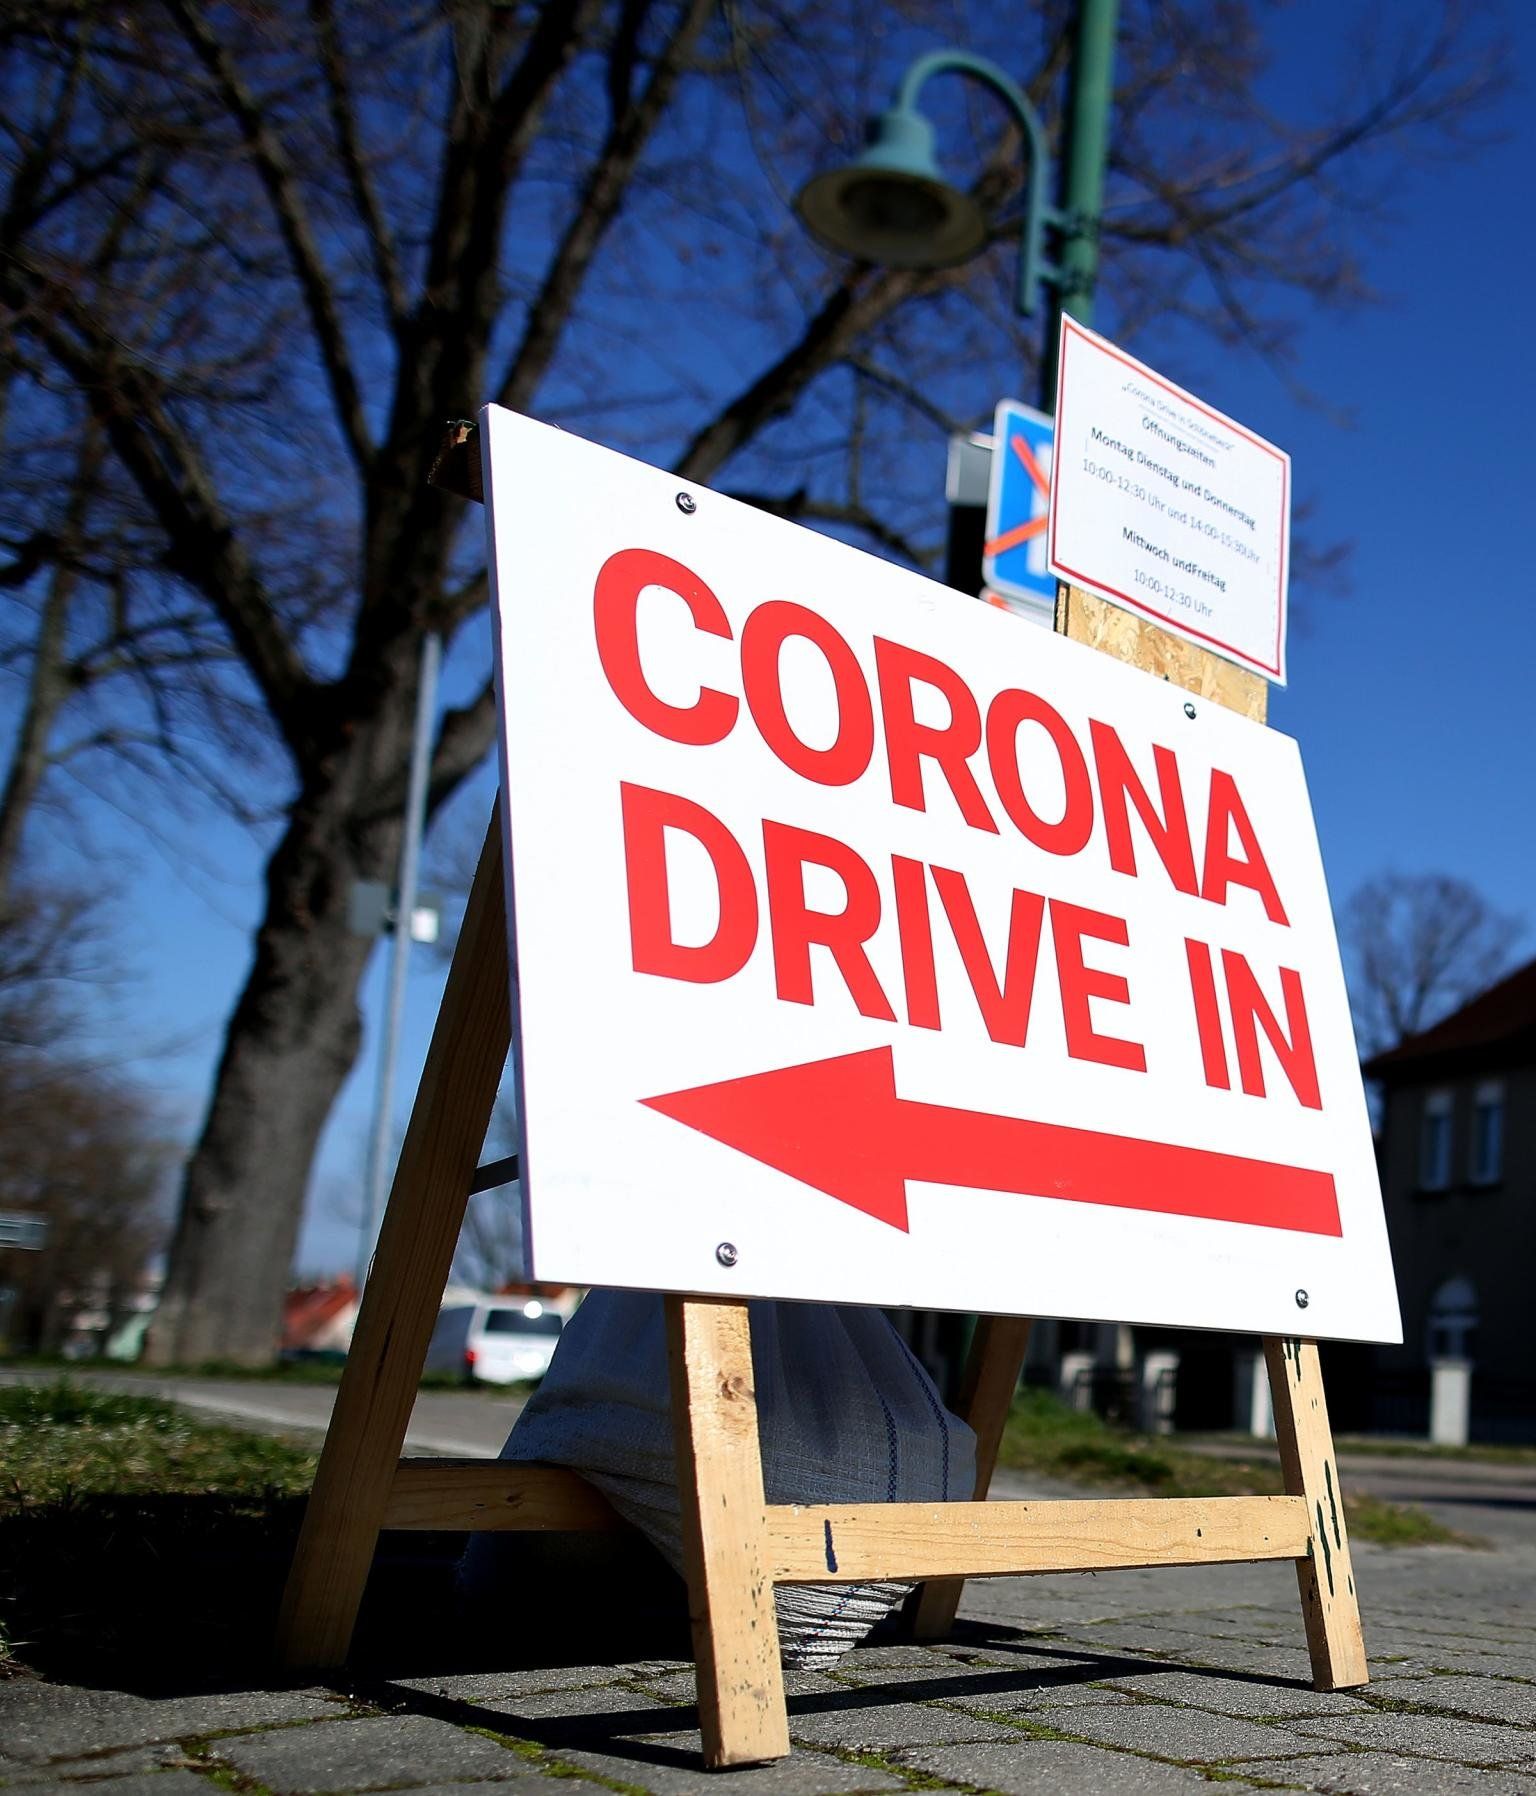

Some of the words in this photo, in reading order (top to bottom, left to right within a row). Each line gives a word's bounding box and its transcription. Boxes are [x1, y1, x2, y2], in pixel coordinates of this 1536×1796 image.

[1083, 458, 1145, 501] 10:00-12:30
[1147, 492, 1166, 512] Uhr
[1167, 506, 1187, 525] und
[1091, 426, 1134, 461] Montag
[1137, 450, 1179, 488] Dienstag
[1181, 480, 1201, 497] und
[1203, 488, 1256, 531] Donnerstag
[1122, 526, 1169, 562] Mittwoch
[1134, 568, 1192, 609] 10:00-12:30
[1194, 599, 1213, 617] Uhr
[593, 548, 1290, 928] CORONA
[620, 780, 1148, 1073] DRIVE
[1185, 937, 1324, 1111] IN
